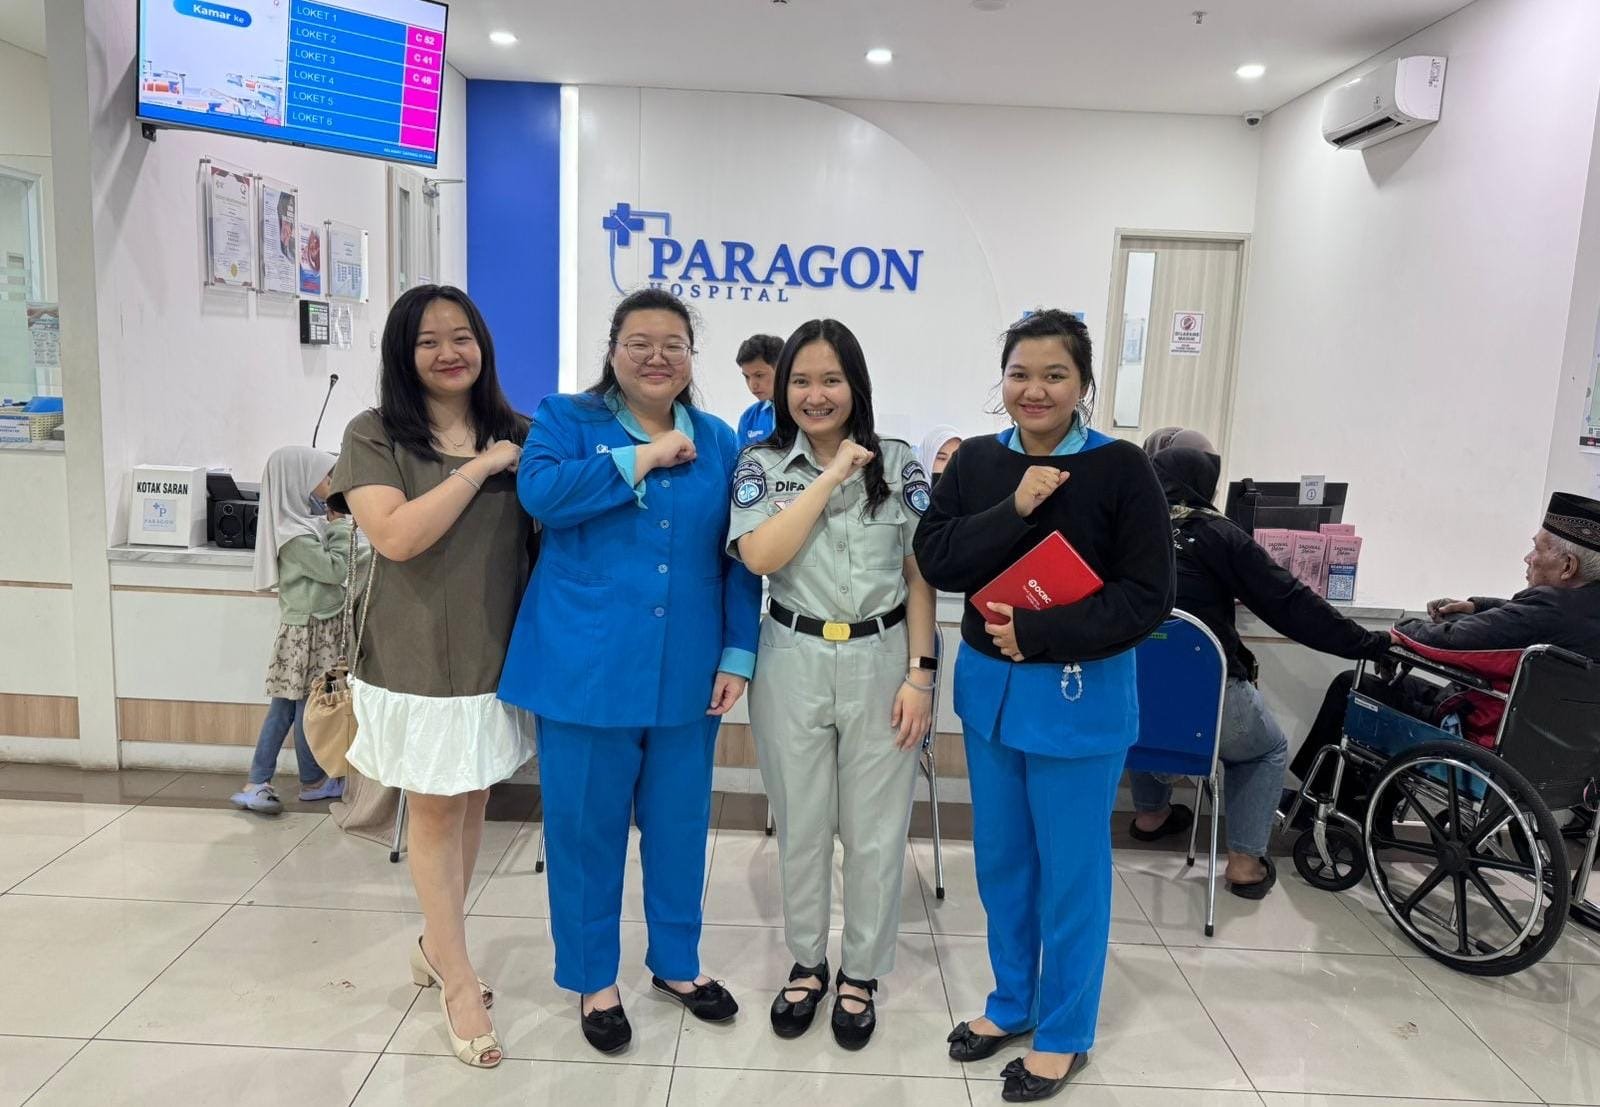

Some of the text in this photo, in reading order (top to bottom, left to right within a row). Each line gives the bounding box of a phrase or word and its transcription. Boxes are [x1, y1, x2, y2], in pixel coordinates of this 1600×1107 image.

[192, 4, 245, 24] Kamar ke
[297, 5, 330, 20] LOKET
[296, 26, 337, 43] LOKET 2
[415, 33, 423, 43] C
[295, 48, 336, 64] LOKET 3
[413, 53, 433, 65] C 41
[294, 69, 335, 85] LOKET 4
[412, 73, 420, 83] C
[293, 90, 334, 106] LOKET 5
[292, 112, 333, 126] LOKET 6
[648, 236, 924, 292] PARAGON
[136, 481, 189, 495] KOTAK SARAN
[775, 480, 806, 492] DIFA
